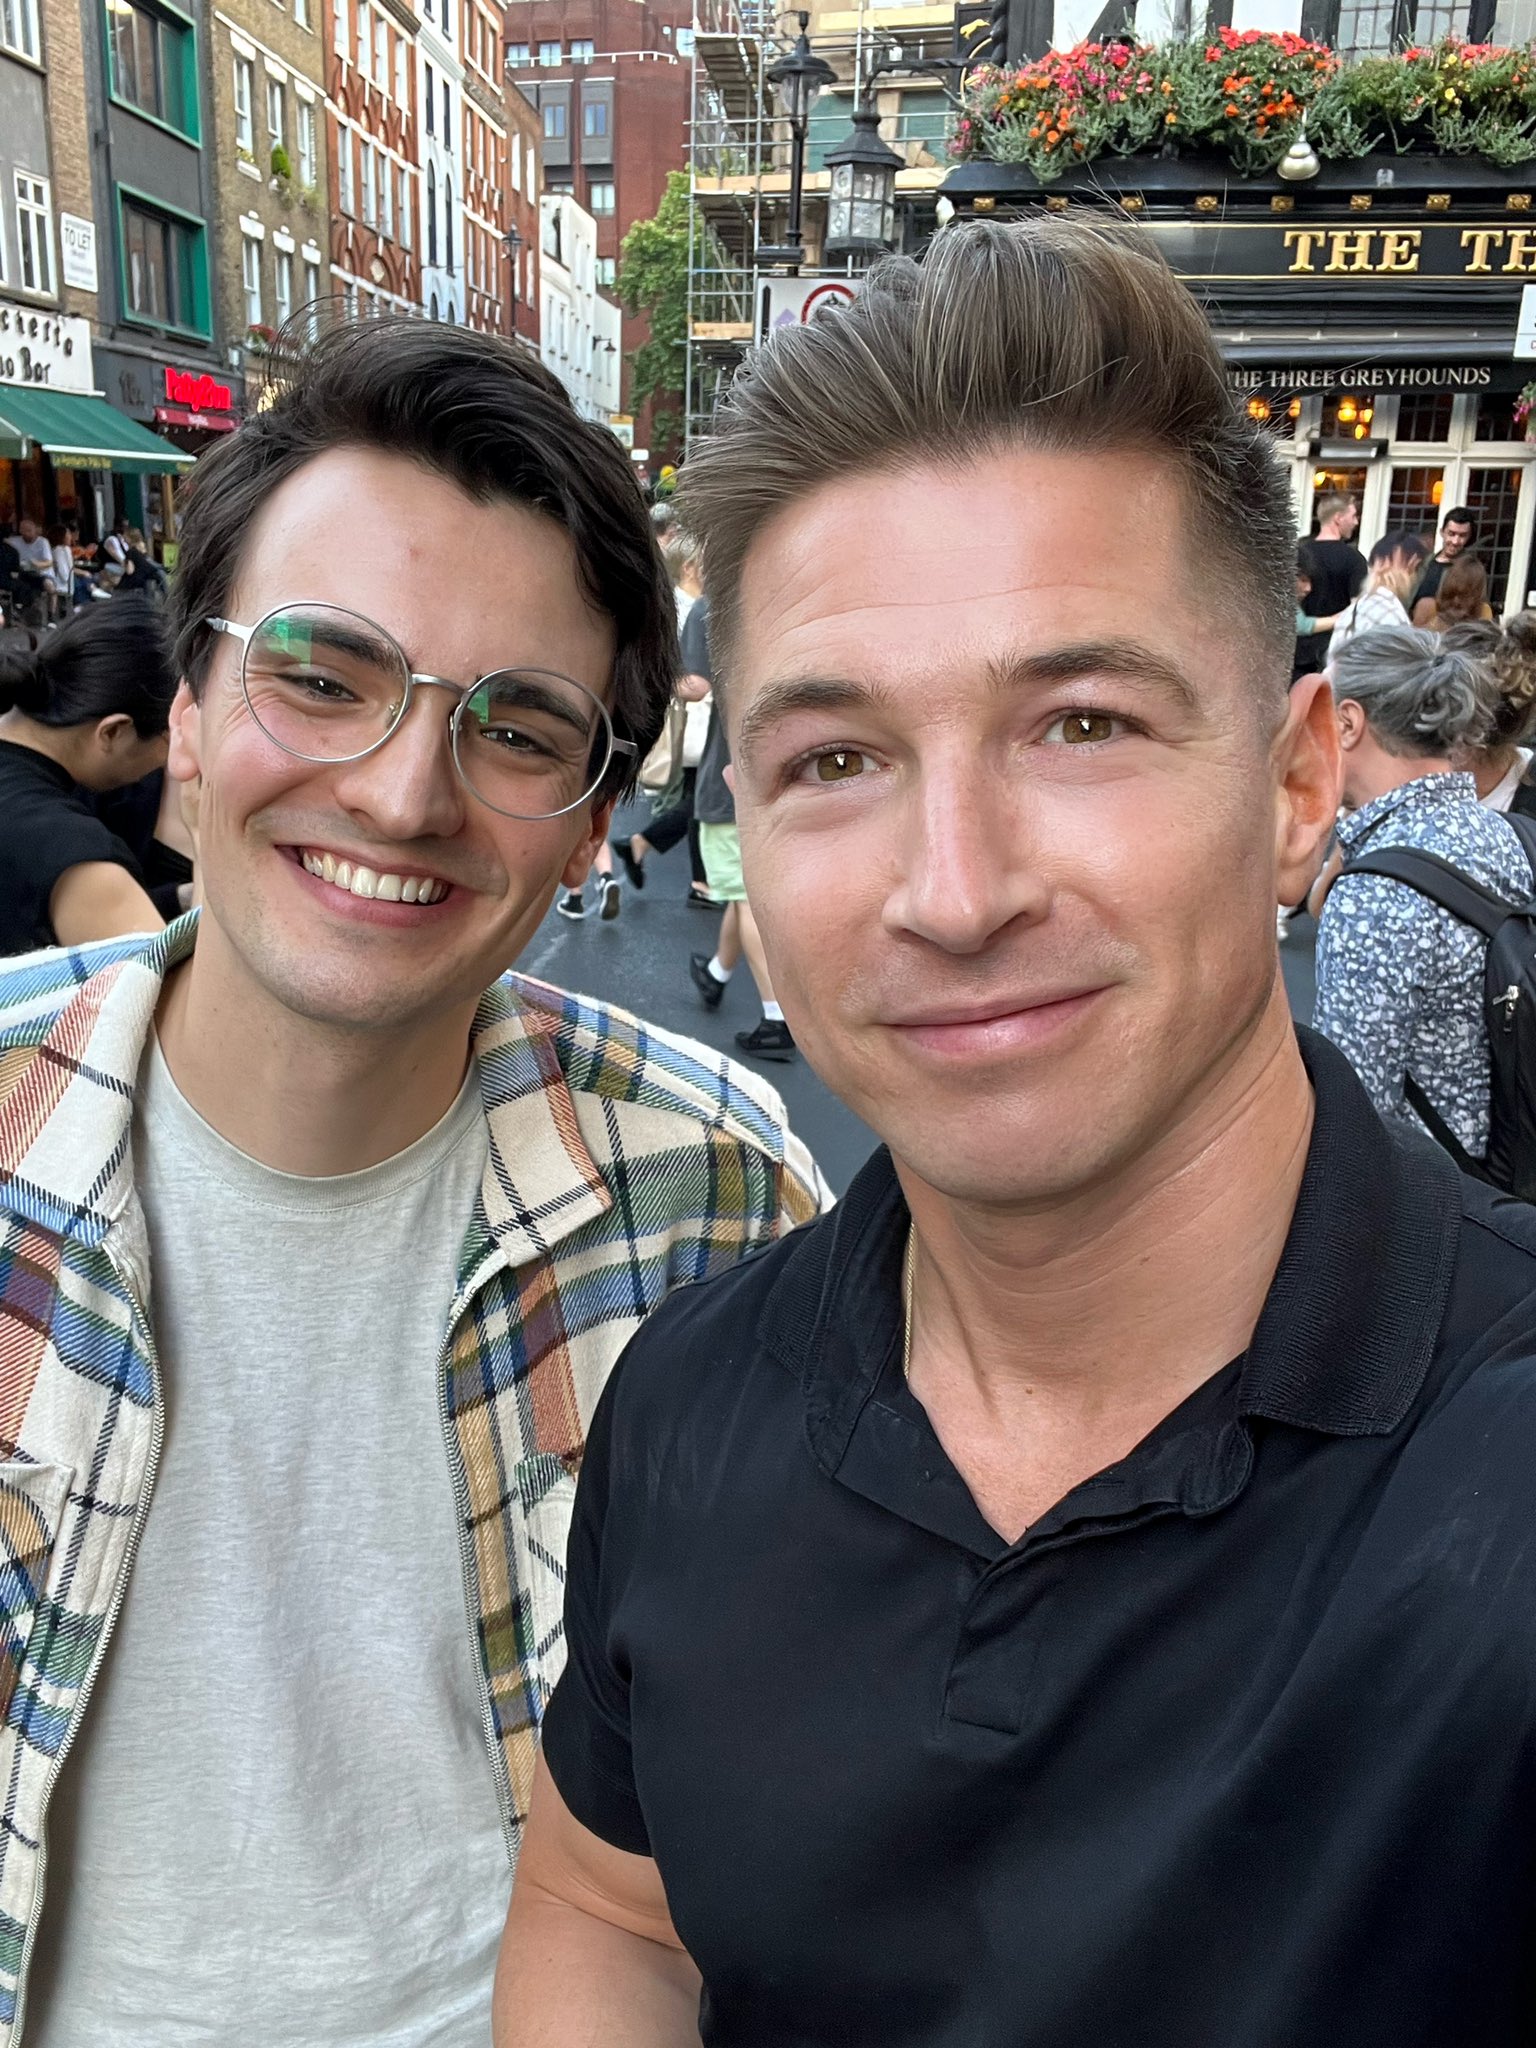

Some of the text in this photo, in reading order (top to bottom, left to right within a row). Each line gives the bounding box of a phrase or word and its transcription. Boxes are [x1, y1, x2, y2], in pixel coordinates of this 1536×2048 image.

[65, 227, 91, 250] TO LET
[1283, 230, 1422, 272] THE
[1266, 369, 1336, 388] THREE
[1340, 367, 1491, 387] GREYHOUNDS
